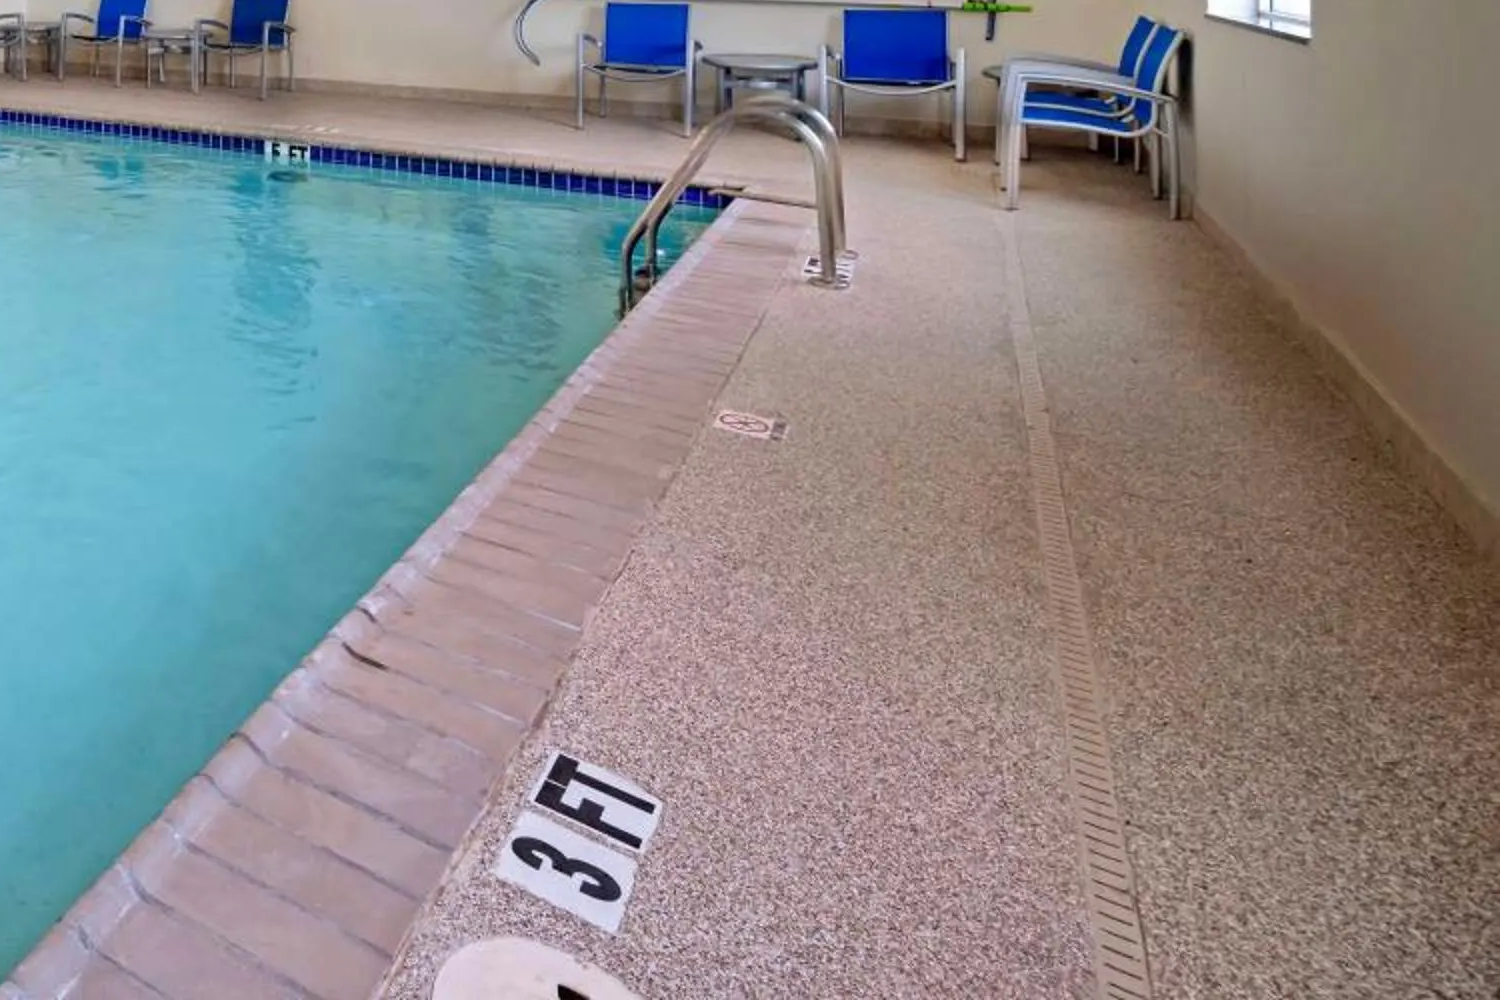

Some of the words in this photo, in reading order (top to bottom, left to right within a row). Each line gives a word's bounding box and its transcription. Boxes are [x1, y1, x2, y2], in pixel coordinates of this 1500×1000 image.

[289, 145, 308, 160] FT
[534, 754, 655, 849] FT
[511, 836, 622, 902] 3
